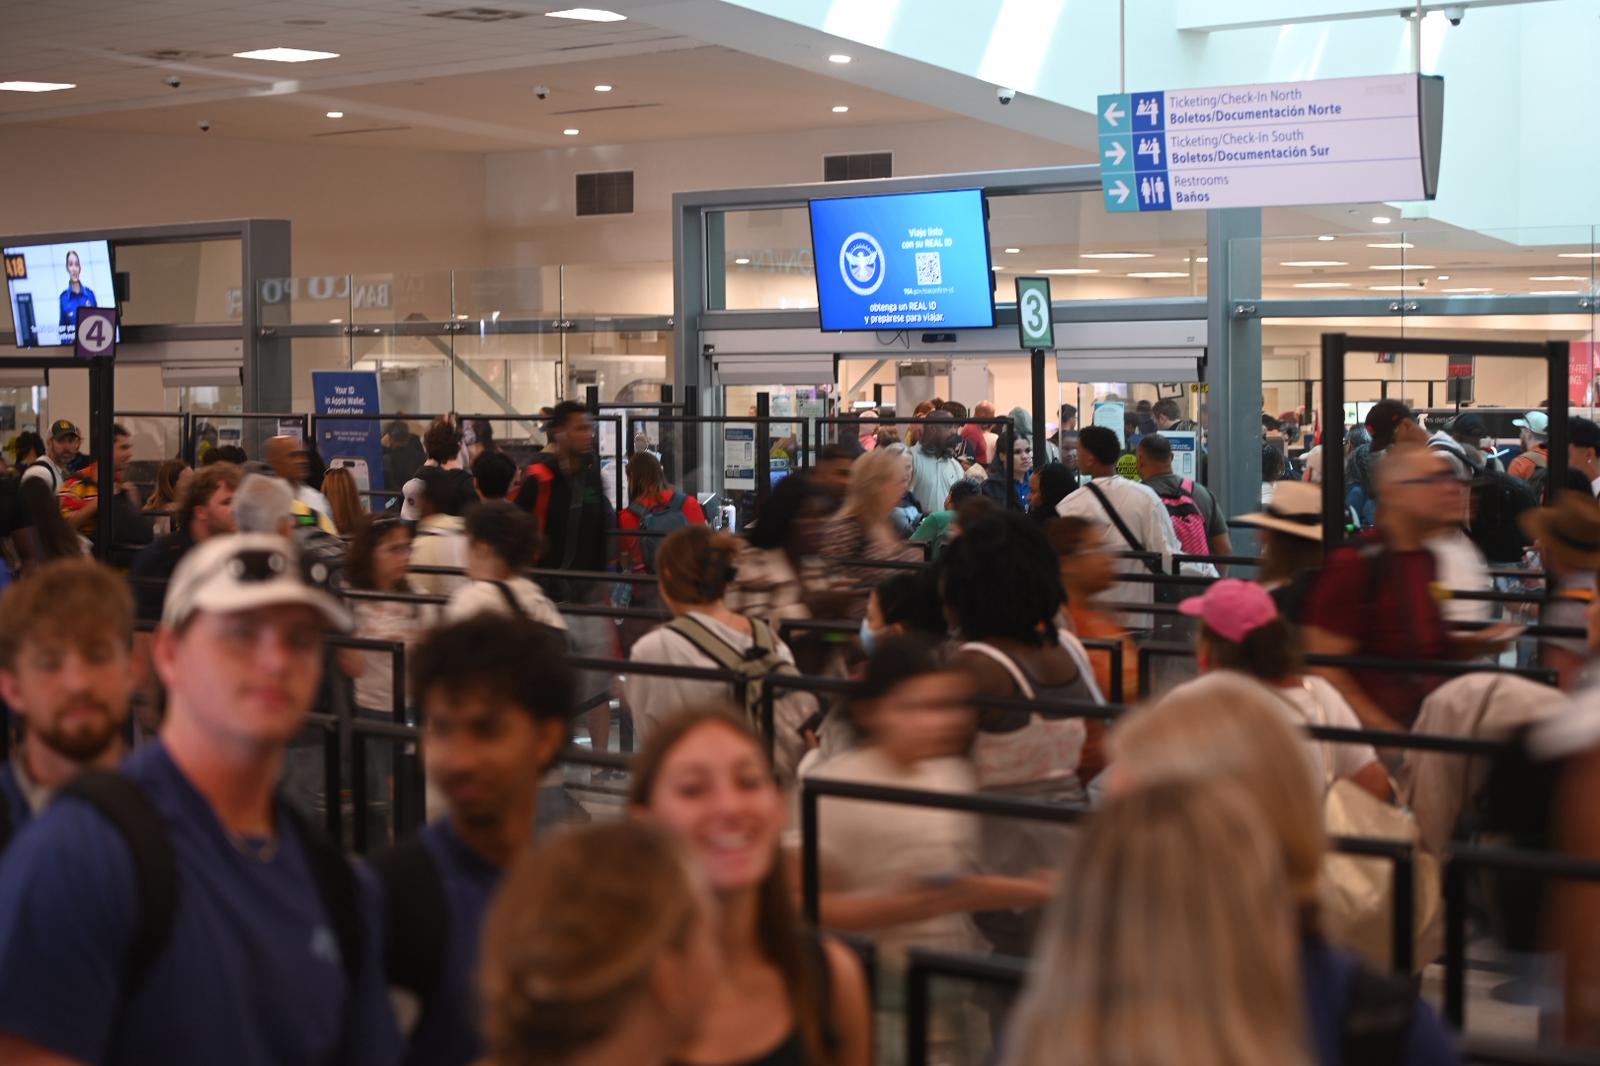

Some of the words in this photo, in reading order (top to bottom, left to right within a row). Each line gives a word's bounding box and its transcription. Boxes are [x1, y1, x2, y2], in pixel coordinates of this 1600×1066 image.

[1170, 92, 1268, 109] Ticketing/Check-In
[1270, 88, 1302, 101] North
[1170, 105, 1305, 125] Boletos/Documentación
[1308, 103, 1341, 115] Norte
[1171, 131, 1269, 149] Ticketing/Check-In
[1271, 129, 1304, 142] South
[1172, 145, 1307, 165] Boletos/Documentación
[1310, 145, 1330, 157] Sur
[1174, 174, 1229, 187] Restrooms
[1176, 190, 1210, 203] Baños
[908, 228, 926, 238] Viaje
[927, 227, 943, 237] listo
[901, 241, 914, 249] con
[915, 241, 924, 249] su
[925, 238, 943, 248] REAL
[944, 238, 953, 248] ID
[869, 302, 897, 313] obtenga
[898, 303, 908, 311] un
[908, 301, 927, 311] REAL
[929, 301, 937, 310] ID
[1026, 295, 1043, 332] 3
[864, 316, 870, 325] y
[871, 313, 904, 325] prepárese
[905, 314, 922, 324] para
[923, 312, 945, 323] viajar.
[85, 320, 106, 347] 4
[334, 386, 347, 394] Your
[348, 386, 355, 394] ID
[331, 397, 346, 406] Apple
